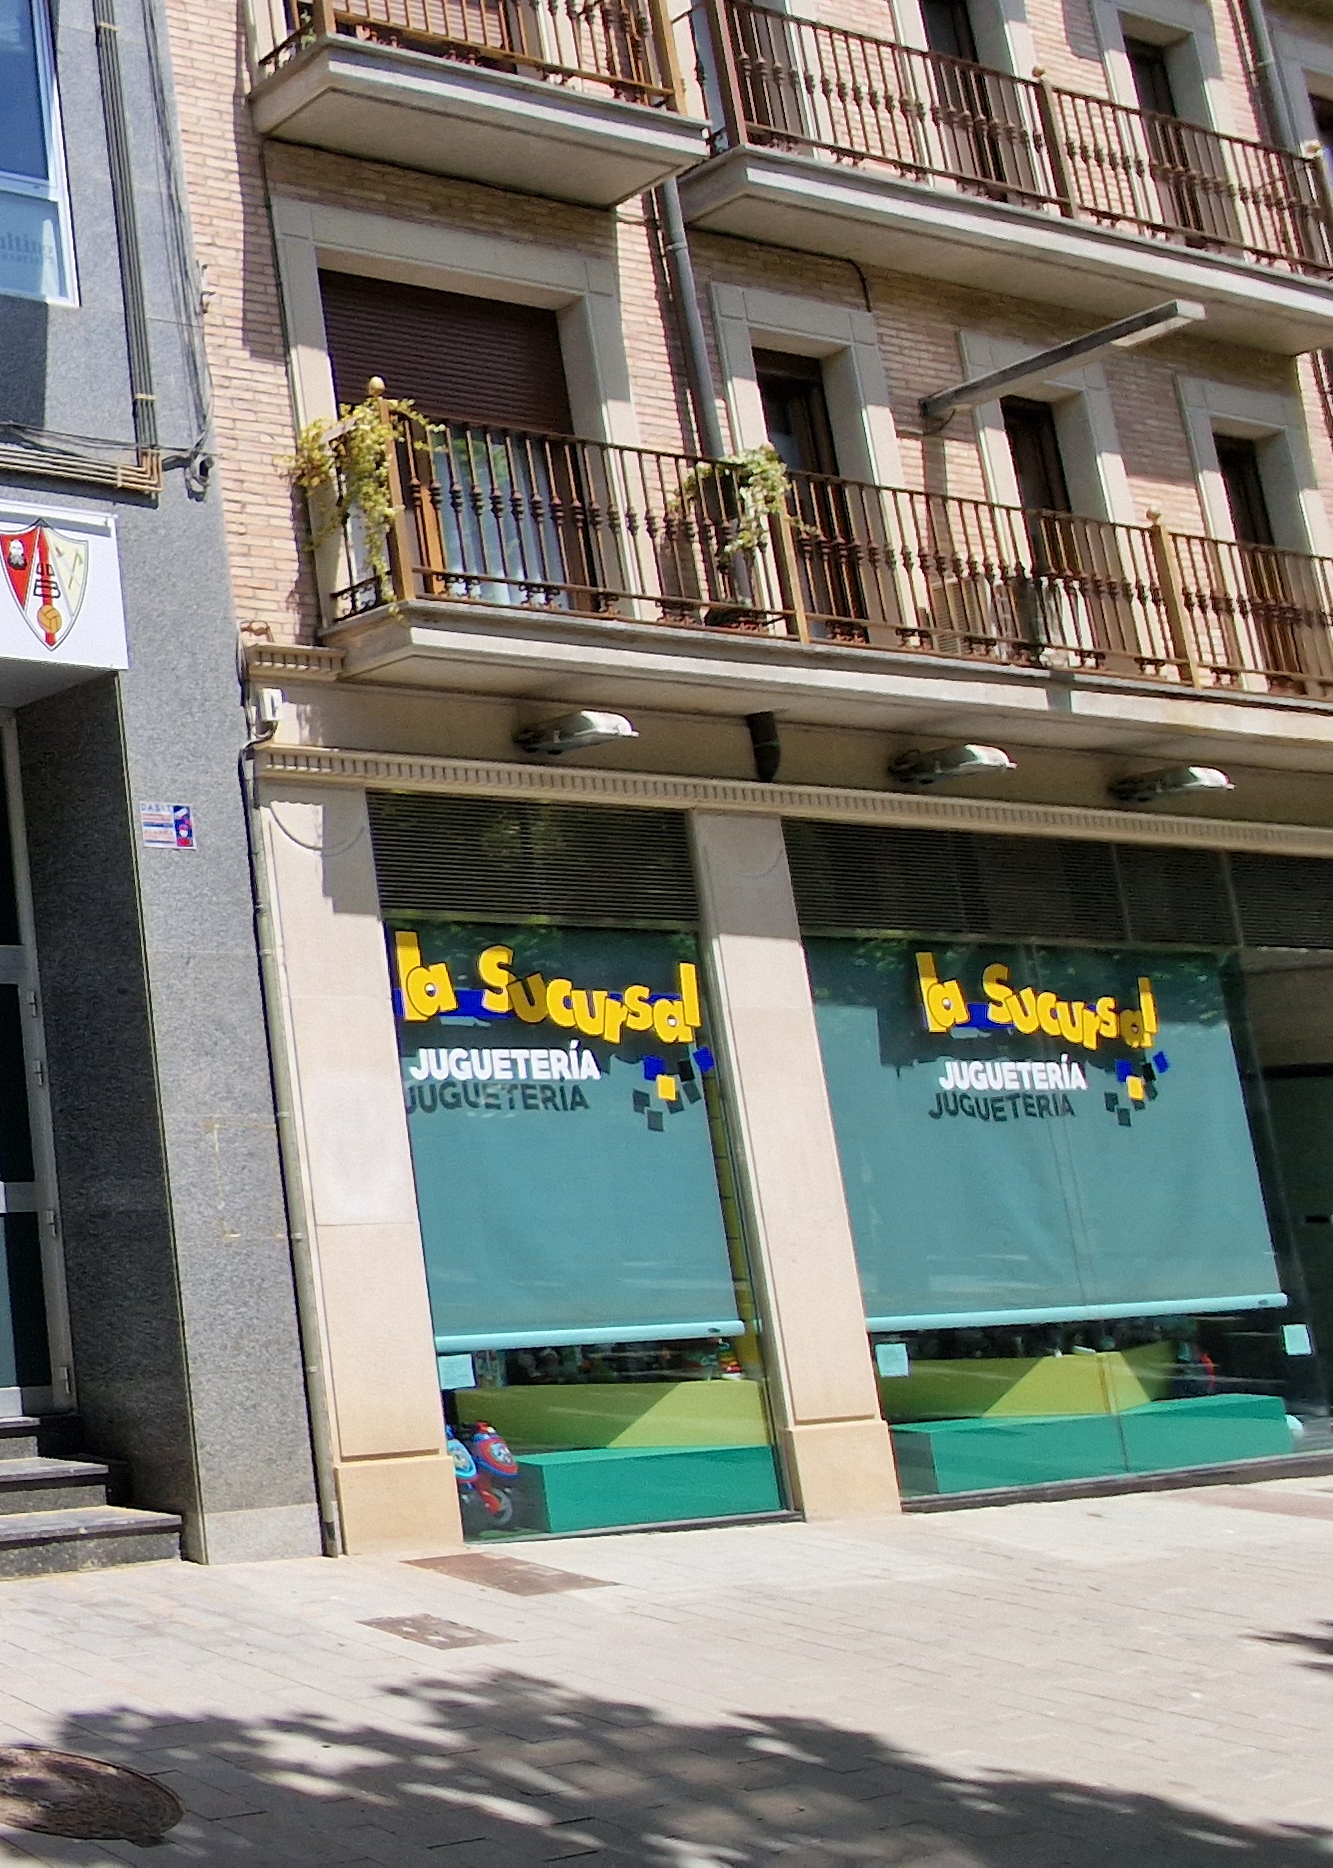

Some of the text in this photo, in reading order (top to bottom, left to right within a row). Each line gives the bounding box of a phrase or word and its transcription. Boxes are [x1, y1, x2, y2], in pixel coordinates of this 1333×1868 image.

[395, 930, 702, 1044] la Sucursal
[915, 951, 1159, 1051] la Sucursal
[409, 1038, 602, 1081] JUGUETERÍA
[938, 1051, 1089, 1091] JUGUETERÍA
